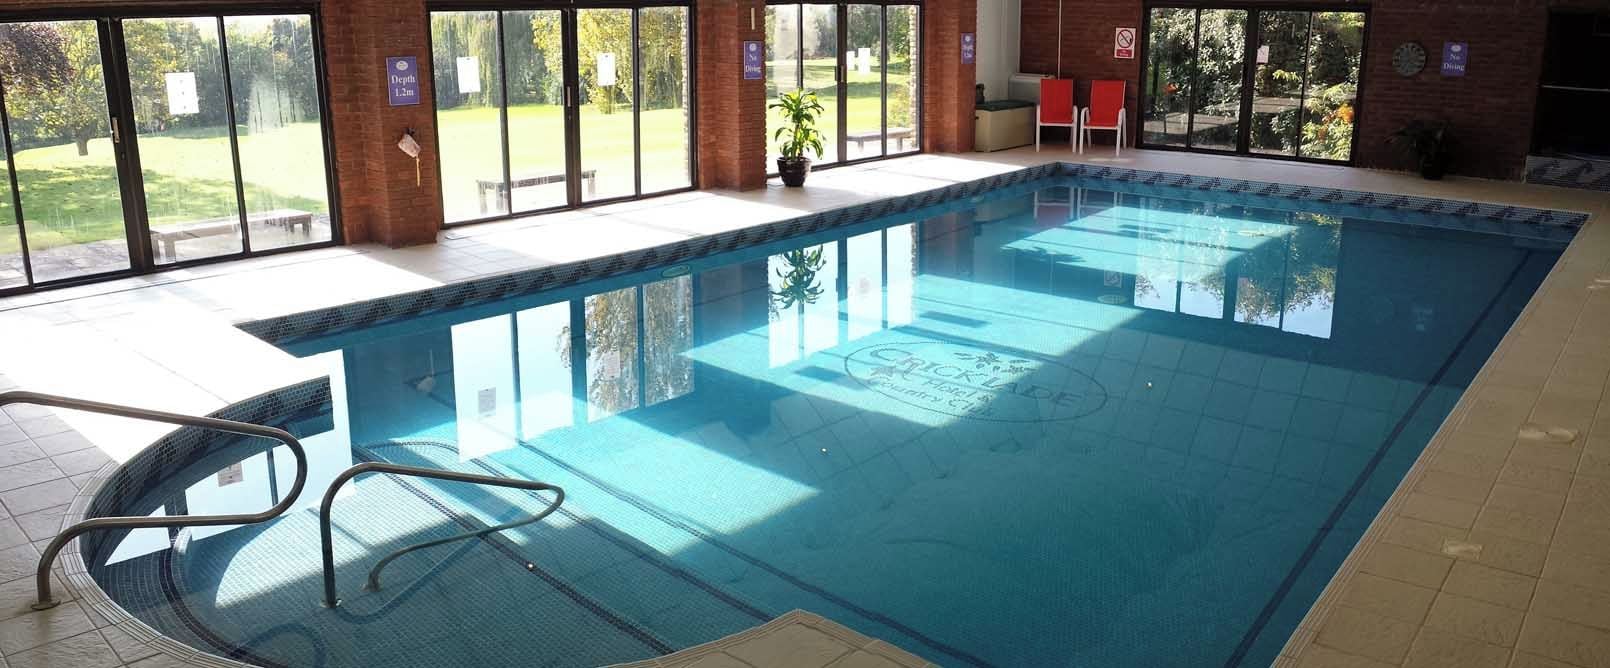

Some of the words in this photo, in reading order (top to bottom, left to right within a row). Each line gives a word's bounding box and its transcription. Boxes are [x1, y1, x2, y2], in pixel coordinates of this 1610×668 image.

[1443, 63, 1465, 71] Diving
[391, 74, 415, 86] Depth
[395, 87, 414, 97] 1.2m
[866, 376, 944, 403] Country
[921, 379, 978, 398] Hotel
